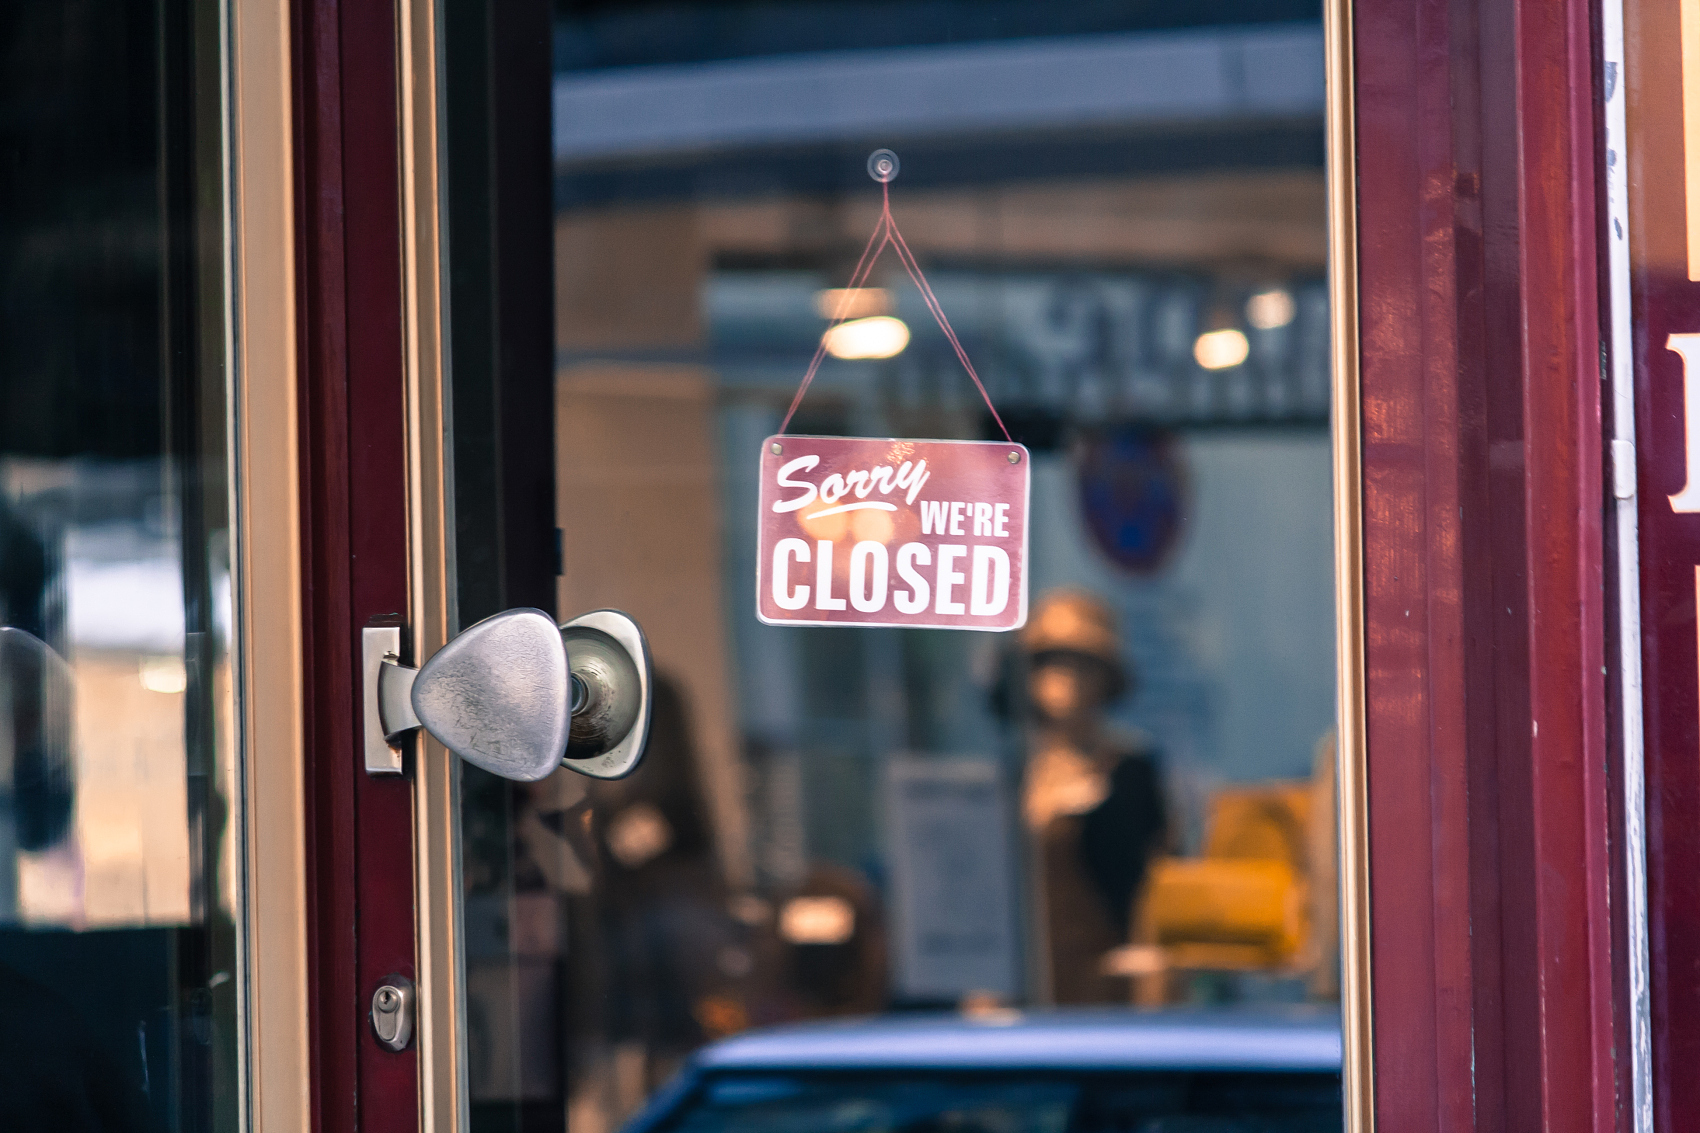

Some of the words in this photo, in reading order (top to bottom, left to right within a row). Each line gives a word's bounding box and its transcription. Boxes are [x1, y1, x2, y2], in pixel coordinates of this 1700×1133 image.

[772, 455, 930, 513] Sorry
[920, 500, 1010, 537] WE'RE
[772, 538, 1011, 616] CLOSED
